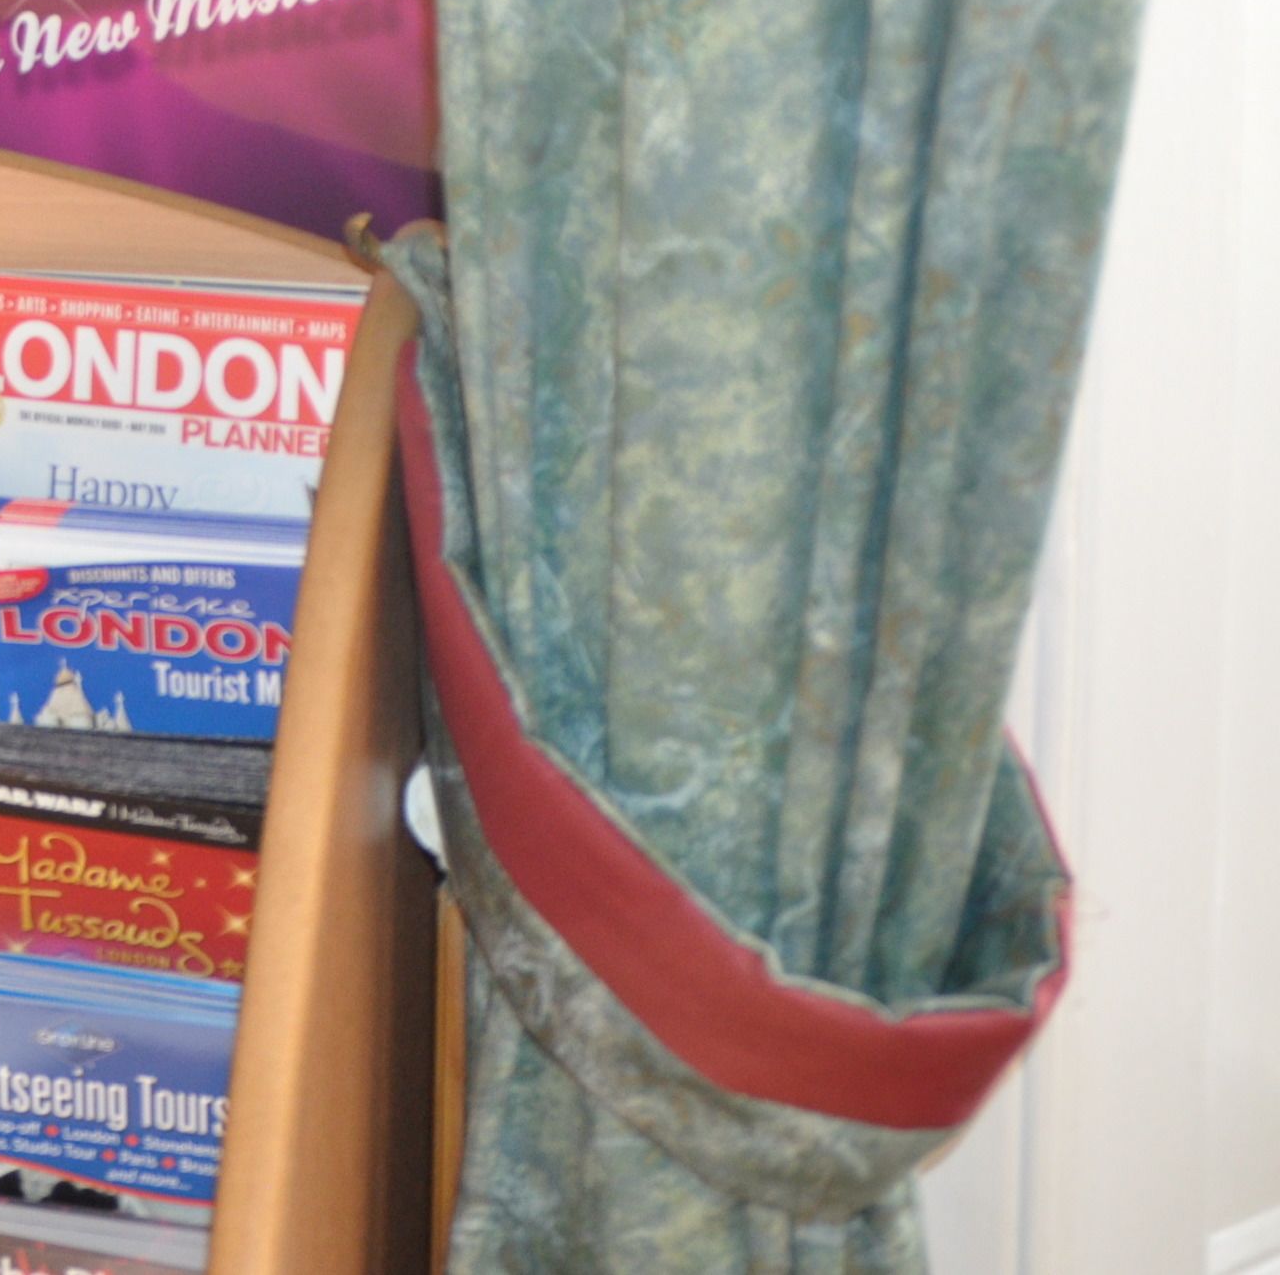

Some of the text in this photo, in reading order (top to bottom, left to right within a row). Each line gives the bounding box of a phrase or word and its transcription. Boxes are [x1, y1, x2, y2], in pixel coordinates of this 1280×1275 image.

[10, 4, 140, 75] New
[17, 296, 47, 314] ARTS
[60, 300, 122, 321] SHOPPING
[136, 308, 179, 325] EATING
[193, 312, 295, 335] ENTERTAINMENT
[309, 321, 347, 340] MAPS
[68, 566, 236, 588] DISCOUNTS AND OFFERS
[152, 662, 250, 704] Tourist
[40, 792, 107, 818] WARS
[136, 1076, 230, 1137] Tours
[63, 1127, 120, 1145] London
